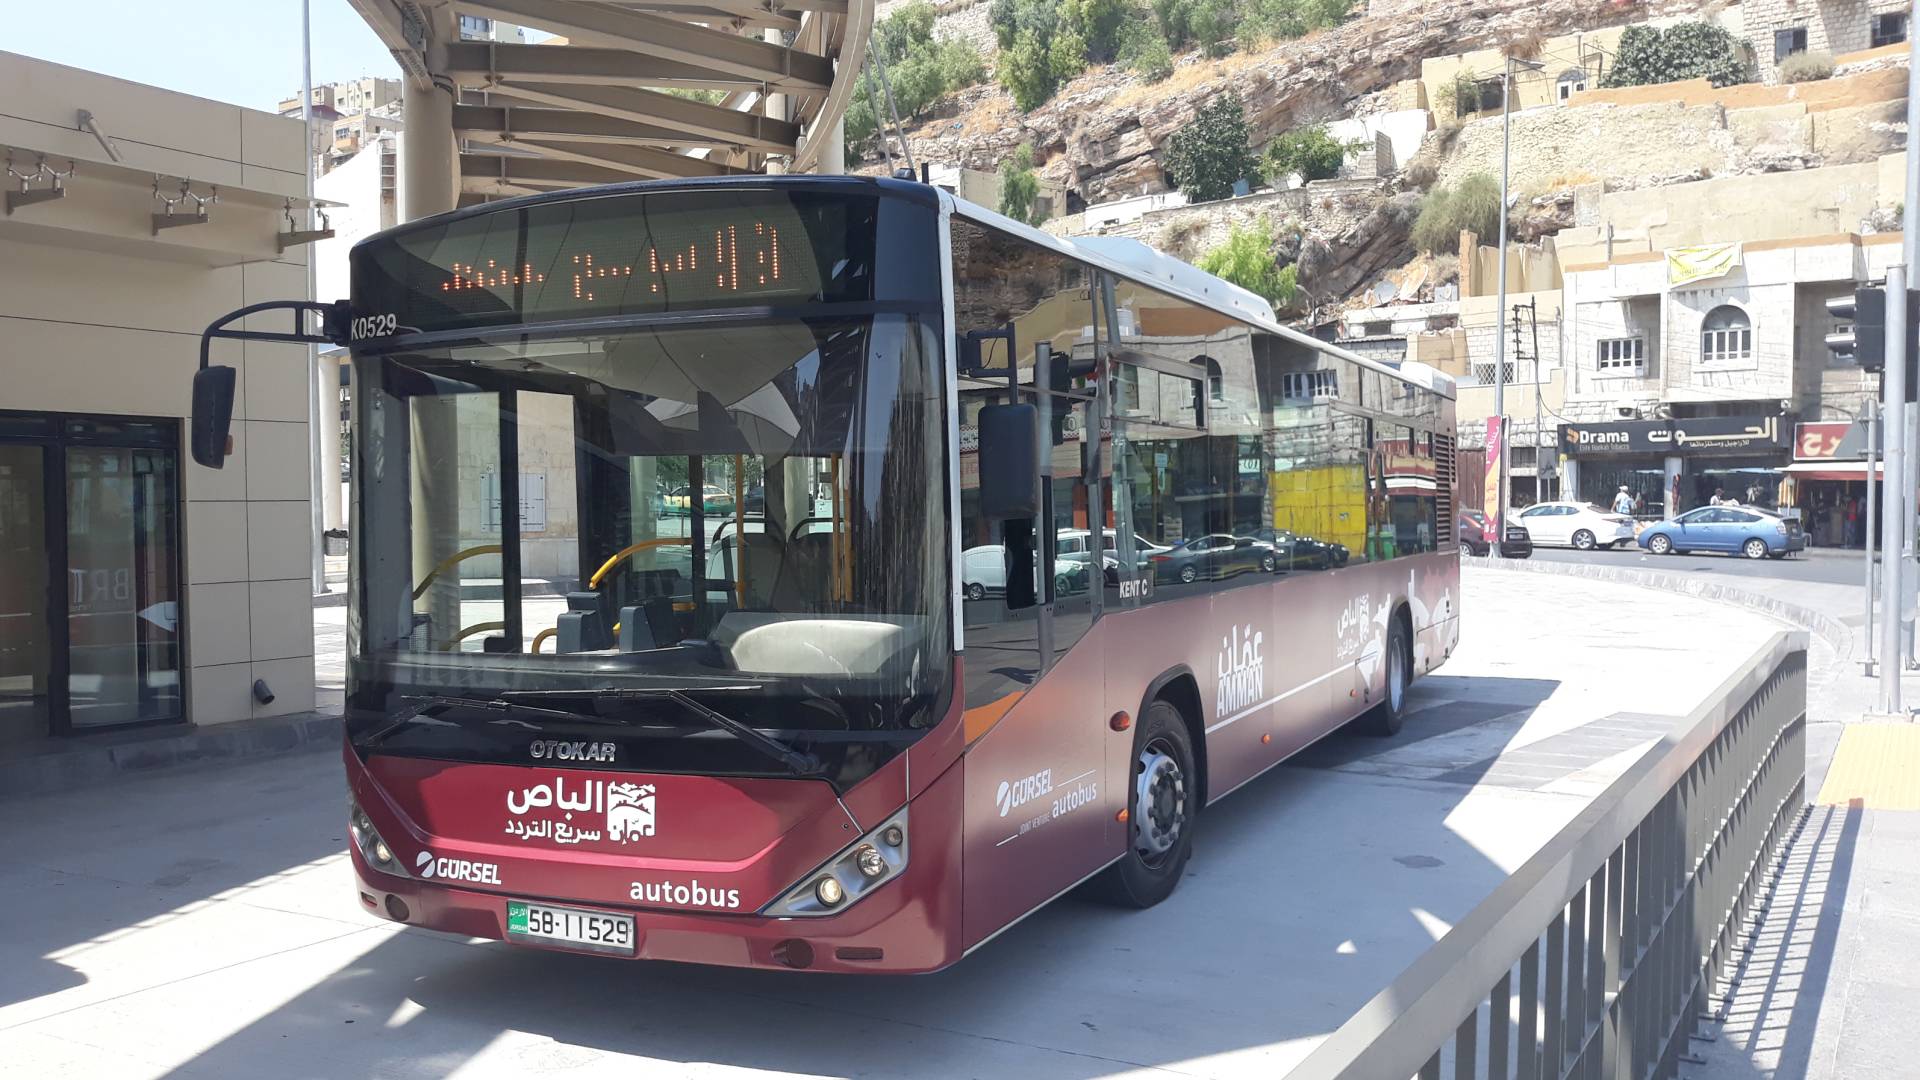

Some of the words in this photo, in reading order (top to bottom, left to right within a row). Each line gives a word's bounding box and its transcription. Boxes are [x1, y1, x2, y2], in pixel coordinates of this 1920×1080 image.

[351, 313, 396, 341] K0529
[1579, 430, 1630, 444] Drama
[1119, 580, 1141, 599] KENT
[1141, 578, 1148, 596] C
[1216, 663, 1264, 718] AMMAN
[530, 739, 616, 762] OTOKAR
[507, 776, 603, 821] الباص
[1052, 782, 1097, 819] autobus
[504, 819, 552, 840] التردد
[554, 821, 601, 844] سريع
[629, 879, 741, 908] autobus
